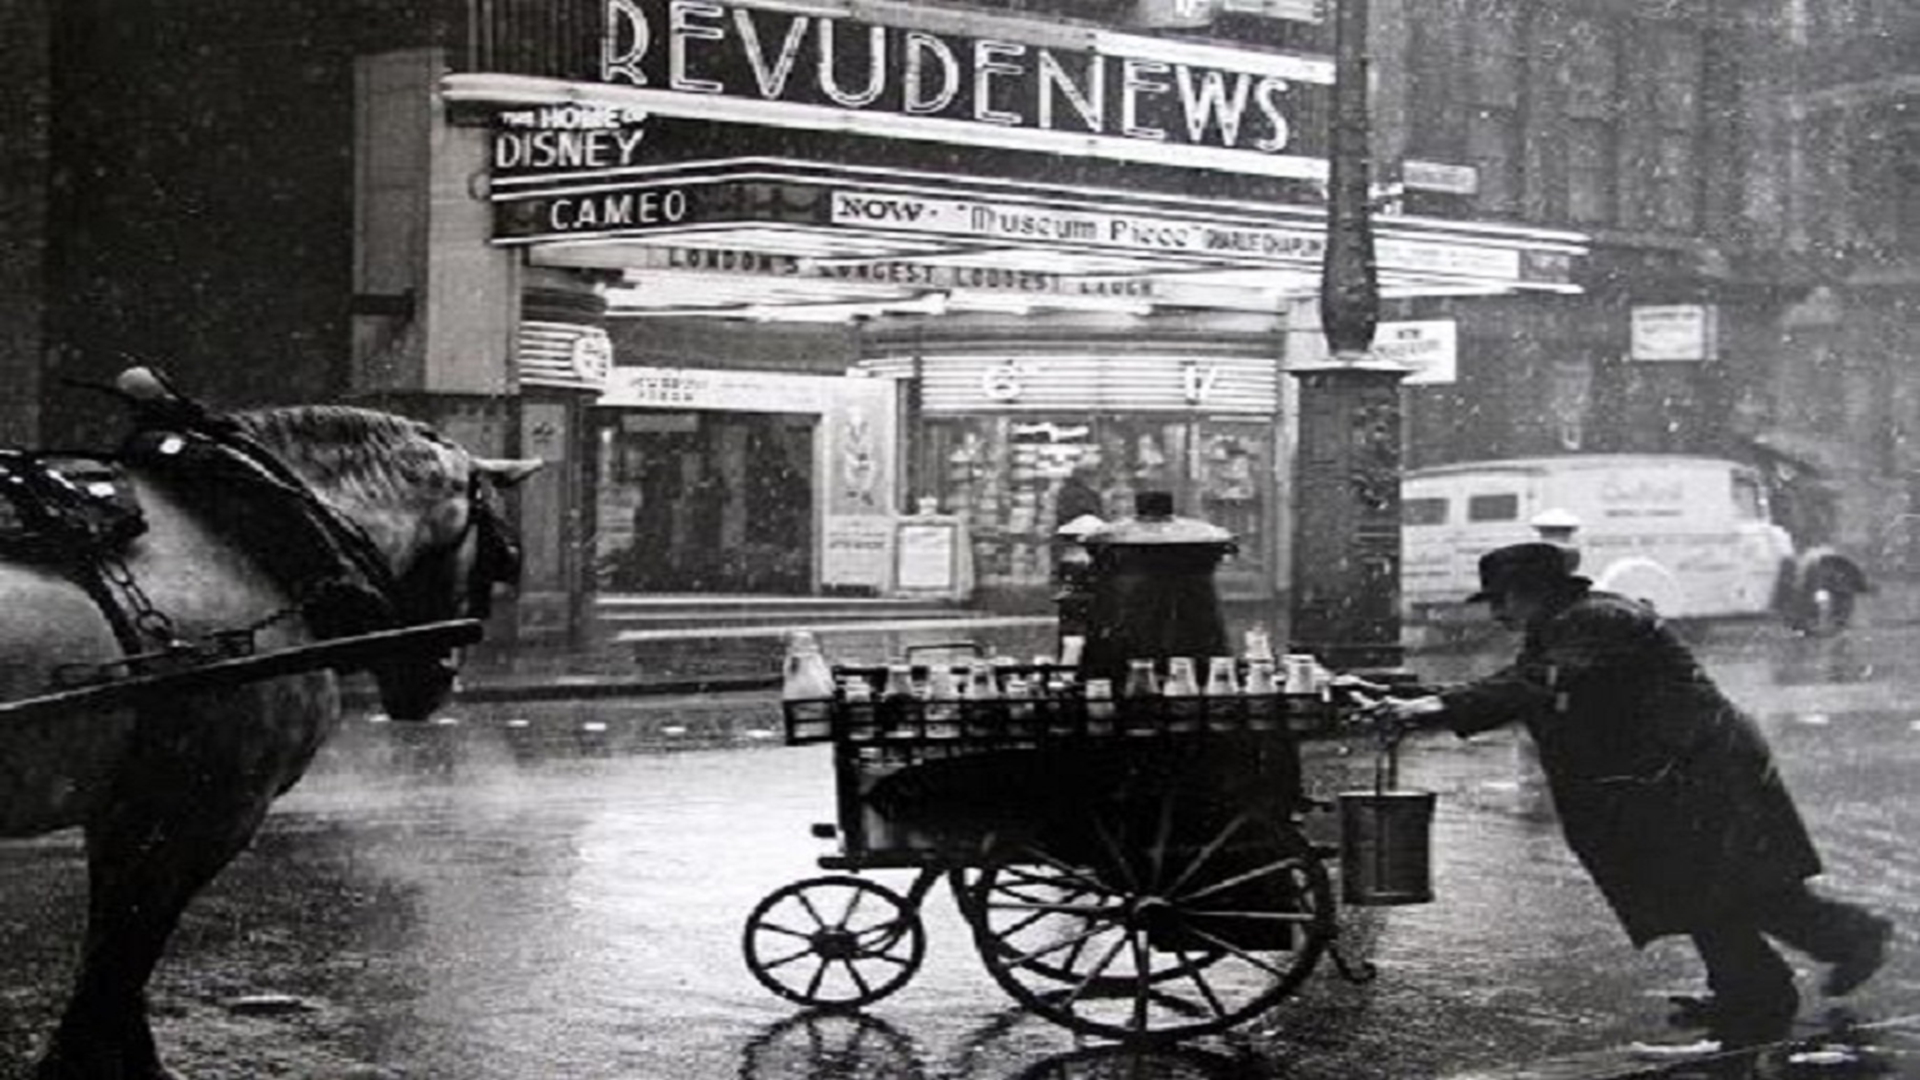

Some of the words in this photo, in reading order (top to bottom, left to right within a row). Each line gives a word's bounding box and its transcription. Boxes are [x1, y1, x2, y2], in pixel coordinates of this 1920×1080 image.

[600, 0, 1289, 151] REVUDENEWS
[540, 106, 621, 129] HOME
[496, 130, 645, 168] DISNEY
[551, 190, 687, 230] CAMEO
